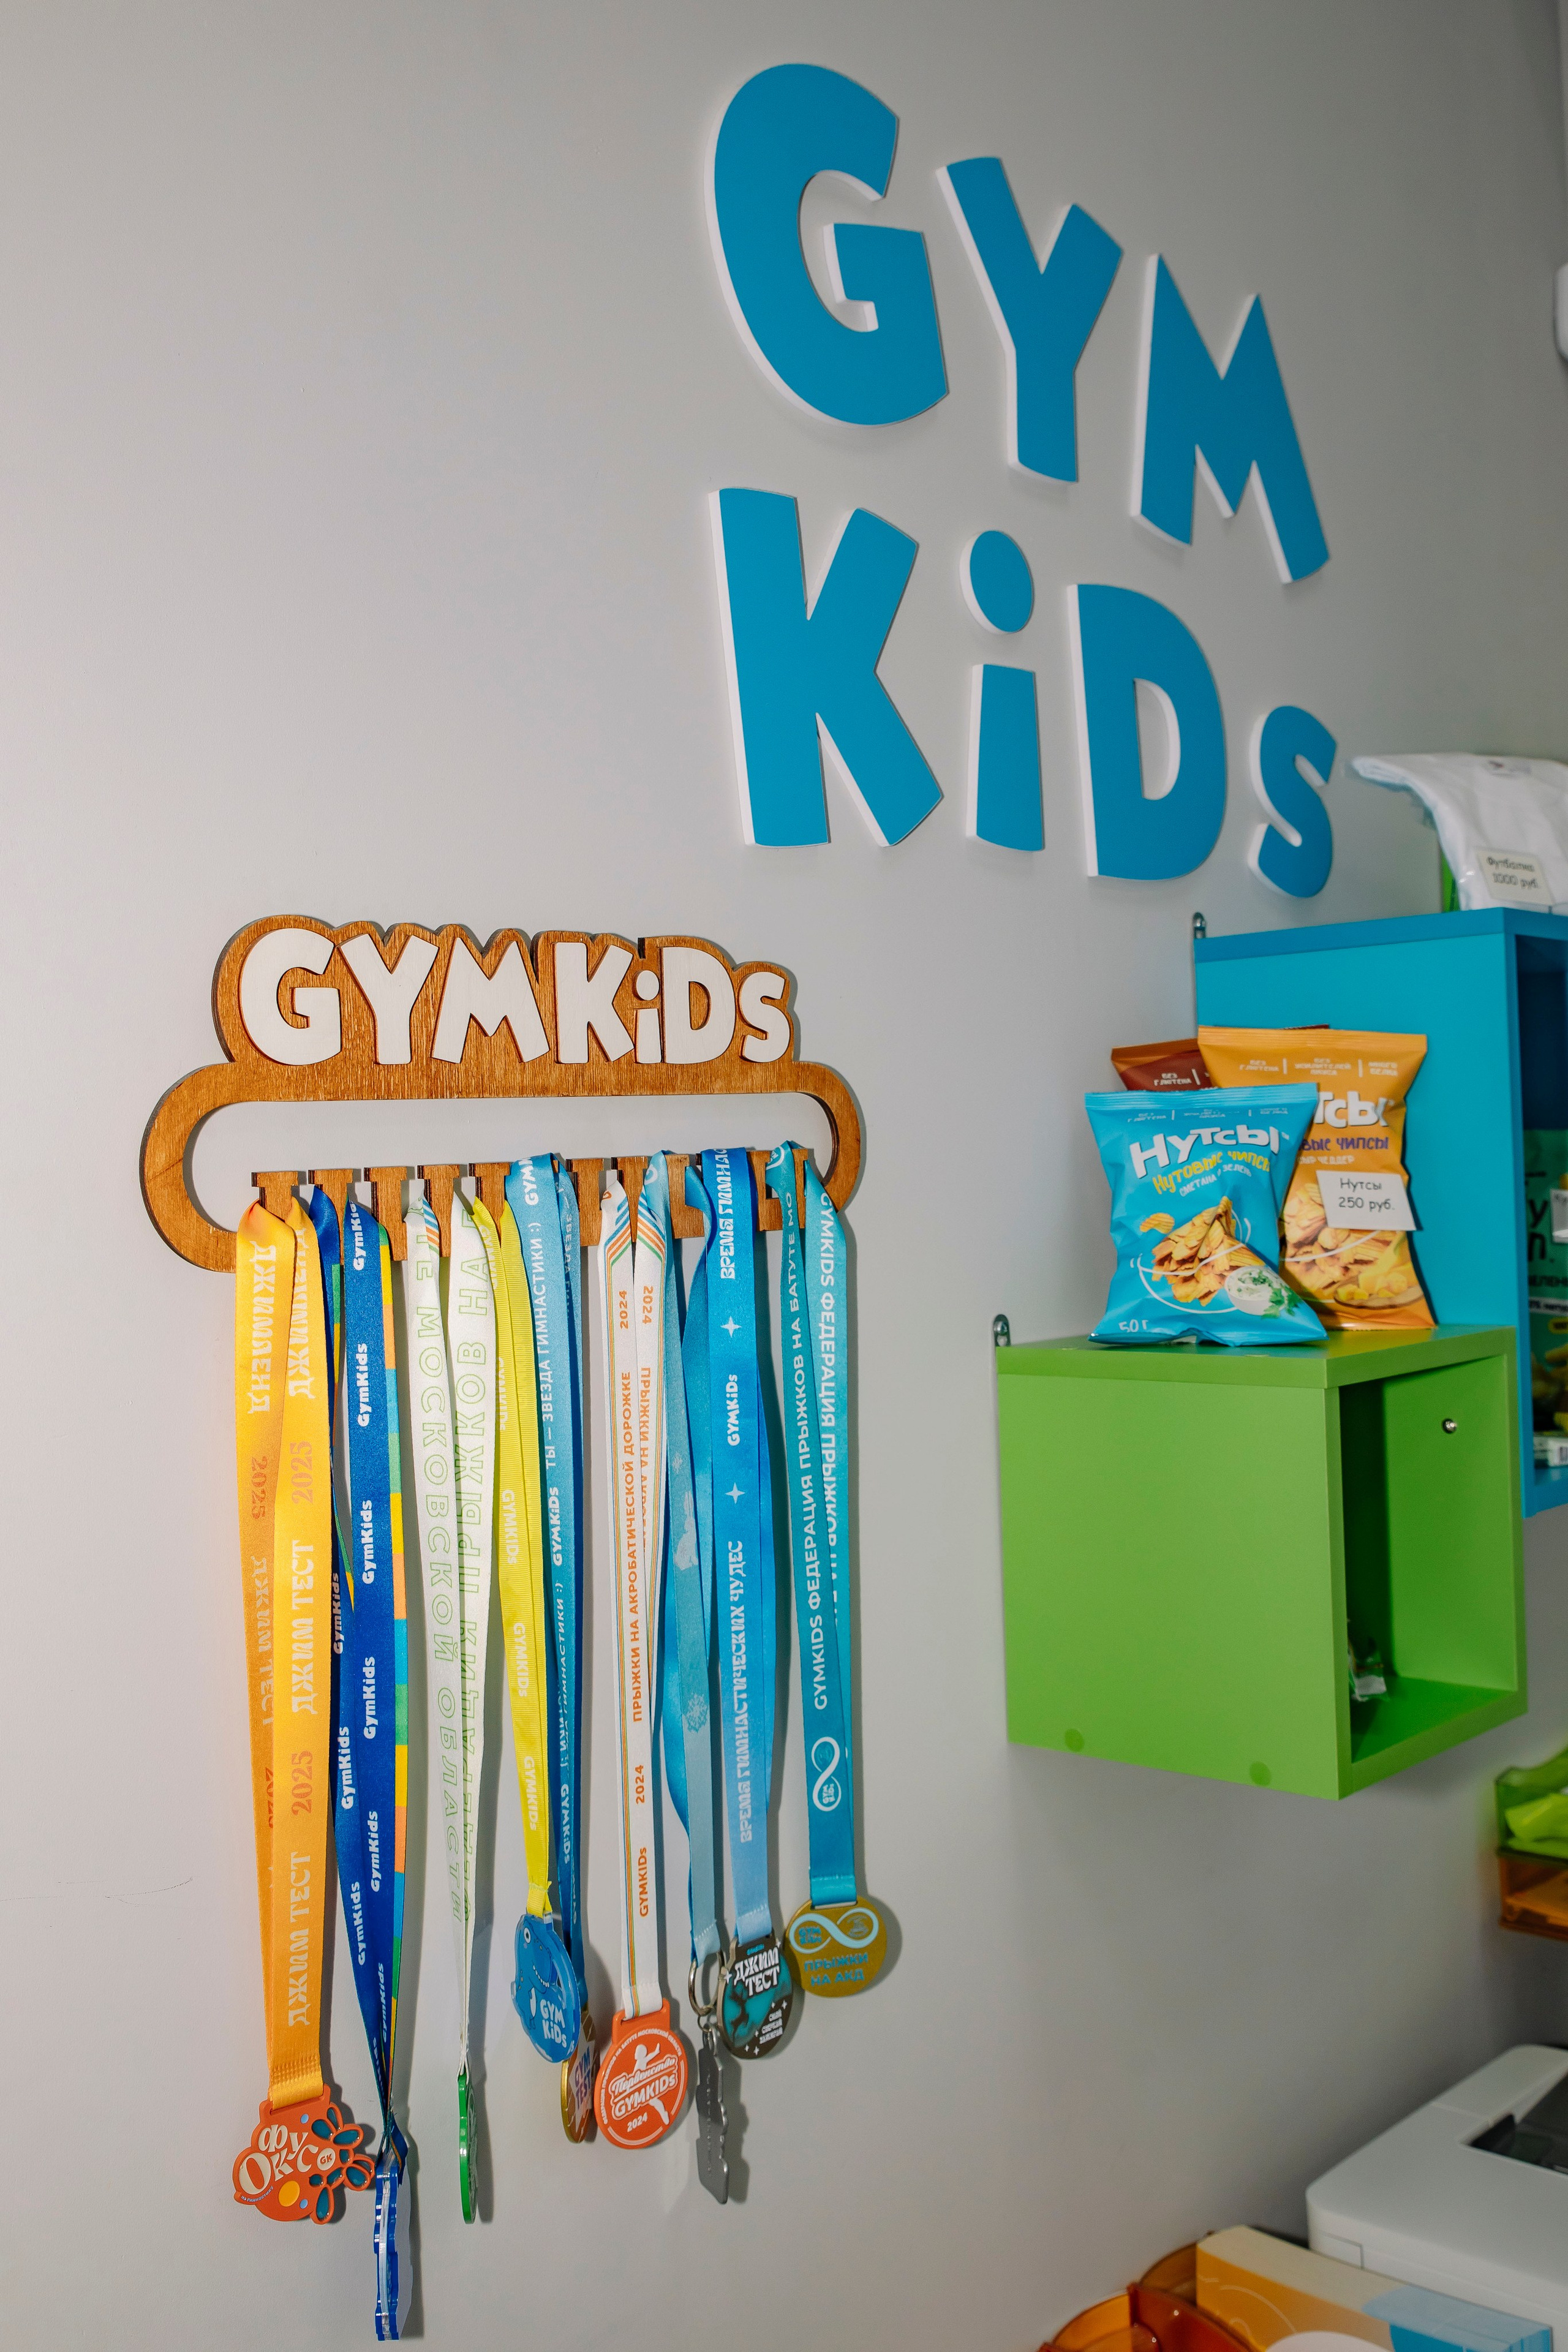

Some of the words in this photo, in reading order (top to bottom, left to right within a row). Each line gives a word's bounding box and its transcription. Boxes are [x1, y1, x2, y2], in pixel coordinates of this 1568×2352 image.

[705, 62, 1330, 585] GYM
[1492, 873, 1518, 886] 1000
[785, 1192, 795, 1227] МО
[1338, 1197, 1364, 1208] 250
[1340, 1177, 1382, 1193] Нутсы
[719, 1218, 735, 1279] ВРЕМЯ
[787, 1232, 799, 1311] БАТУТЕ
[820, 1192, 835, 1287] GYMKIDS
[247, 1240, 277, 1414] ДЖИМЛЕНД
[530, 1238, 550, 1355] ГИМНАСТИКИ
[619, 1290, 628, 1330] 2024
[642, 1286, 654, 1324] 2024
[791, 1317, 803, 1349] НА
[1118, 1321, 1139, 1333] 50
[356, 1343, 371, 1427] GymKids
[540, 1360, 554, 1422] ЗВЕЗДА
[818, 1292, 835, 1427] ФЕДЕРАЦИЯ
[620, 1372, 635, 1455] ДОРОЖКЕ
[639, 1368, 652, 1441] ПРЫЖКИ
[793, 1354, 812, 1469] ПРЫЖКОВ
[252, 1457, 268, 1520] 2025
[290, 1441, 314, 1504] 2025
[417, 1306, 458, 1662] МОСКОВСКОЙ
[454, 1342, 486, 1593] ПРЫЖКОВ
[545, 1445, 556, 1469] ТЫ
[361, 1501, 376, 1584] GymKids
[622, 1461, 639, 1615] АКРОБАТИЧЕСКОЙ
[728, 1540, 746, 1602] ЧУДЕС
[801, 1476, 821, 1610] ФЕДЕРАЦИЯ
[251, 1556, 272, 1652] ДЖИМ
[292, 1540, 314, 1610] ТЕСТ
[330, 1570, 344, 1656] GymKids
[629, 1619, 639, 1642] НА
[292, 1618, 318, 1714] ДЖИМ
[556, 1598, 568, 1714] ГИМНАСТИКИ
[630, 1648, 643, 1722] ПРЫЖКИ
[730, 1605, 750, 1779] ГИМНАСТИЧЕСКИХ
[810, 1615, 827, 1709] GYMKIDS
[363, 1657, 378, 1739] GymKids
[291, 1751, 313, 1815] 2025
[337, 1727, 355, 1809] GymKids
[635, 1765, 645, 1804] 2024
[437, 1687, 462, 1923] ОБЛАСТИ
[738, 1780, 753, 1844] ВРЕМЯ
[289, 1851, 311, 1923] ТЕСТ
[368, 1812, 381, 1891] GymKids
[349, 1882, 365, 1967] GymKids
[288, 1928, 311, 2027] ДЖИМ
[733, 1947, 780, 1986] ДЖИМ
[745, 1965, 780, 1997] ТЕСТ
[804, 1951, 869, 1972] ПРЫЖКИ
[810, 1973, 831, 1986] НА
[834, 1968, 865, 1983] АКД
[540, 1999, 565, 2029] GYM
[613, 2057, 676, 2096] Первенство
[627, 2111, 648, 2133] 2024
